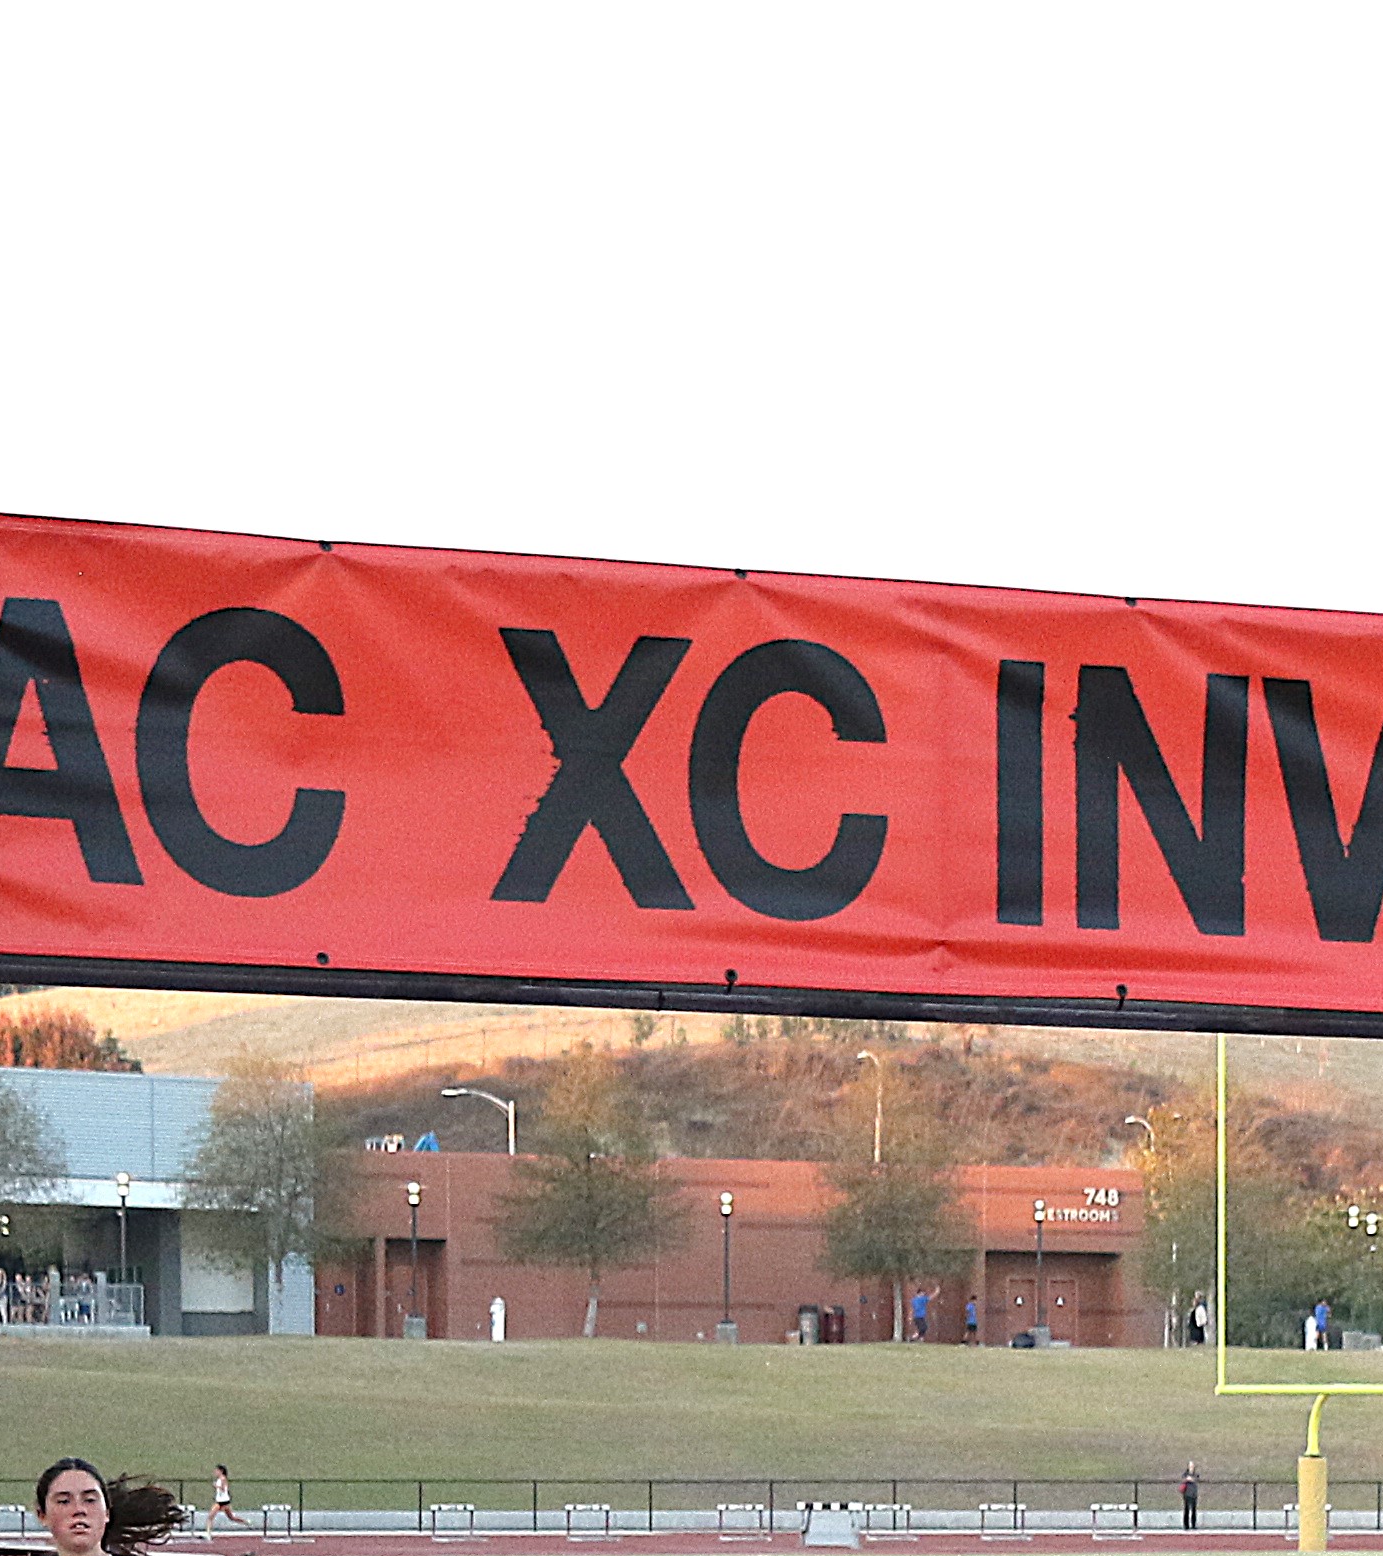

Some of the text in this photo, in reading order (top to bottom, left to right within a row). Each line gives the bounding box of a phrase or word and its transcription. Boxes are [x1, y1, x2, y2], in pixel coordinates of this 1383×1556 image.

[489, 627, 888, 921] XC
[1083, 1187, 1119, 1206] 748
[1041, 1207, 1119, 1222] ESTROOMS
